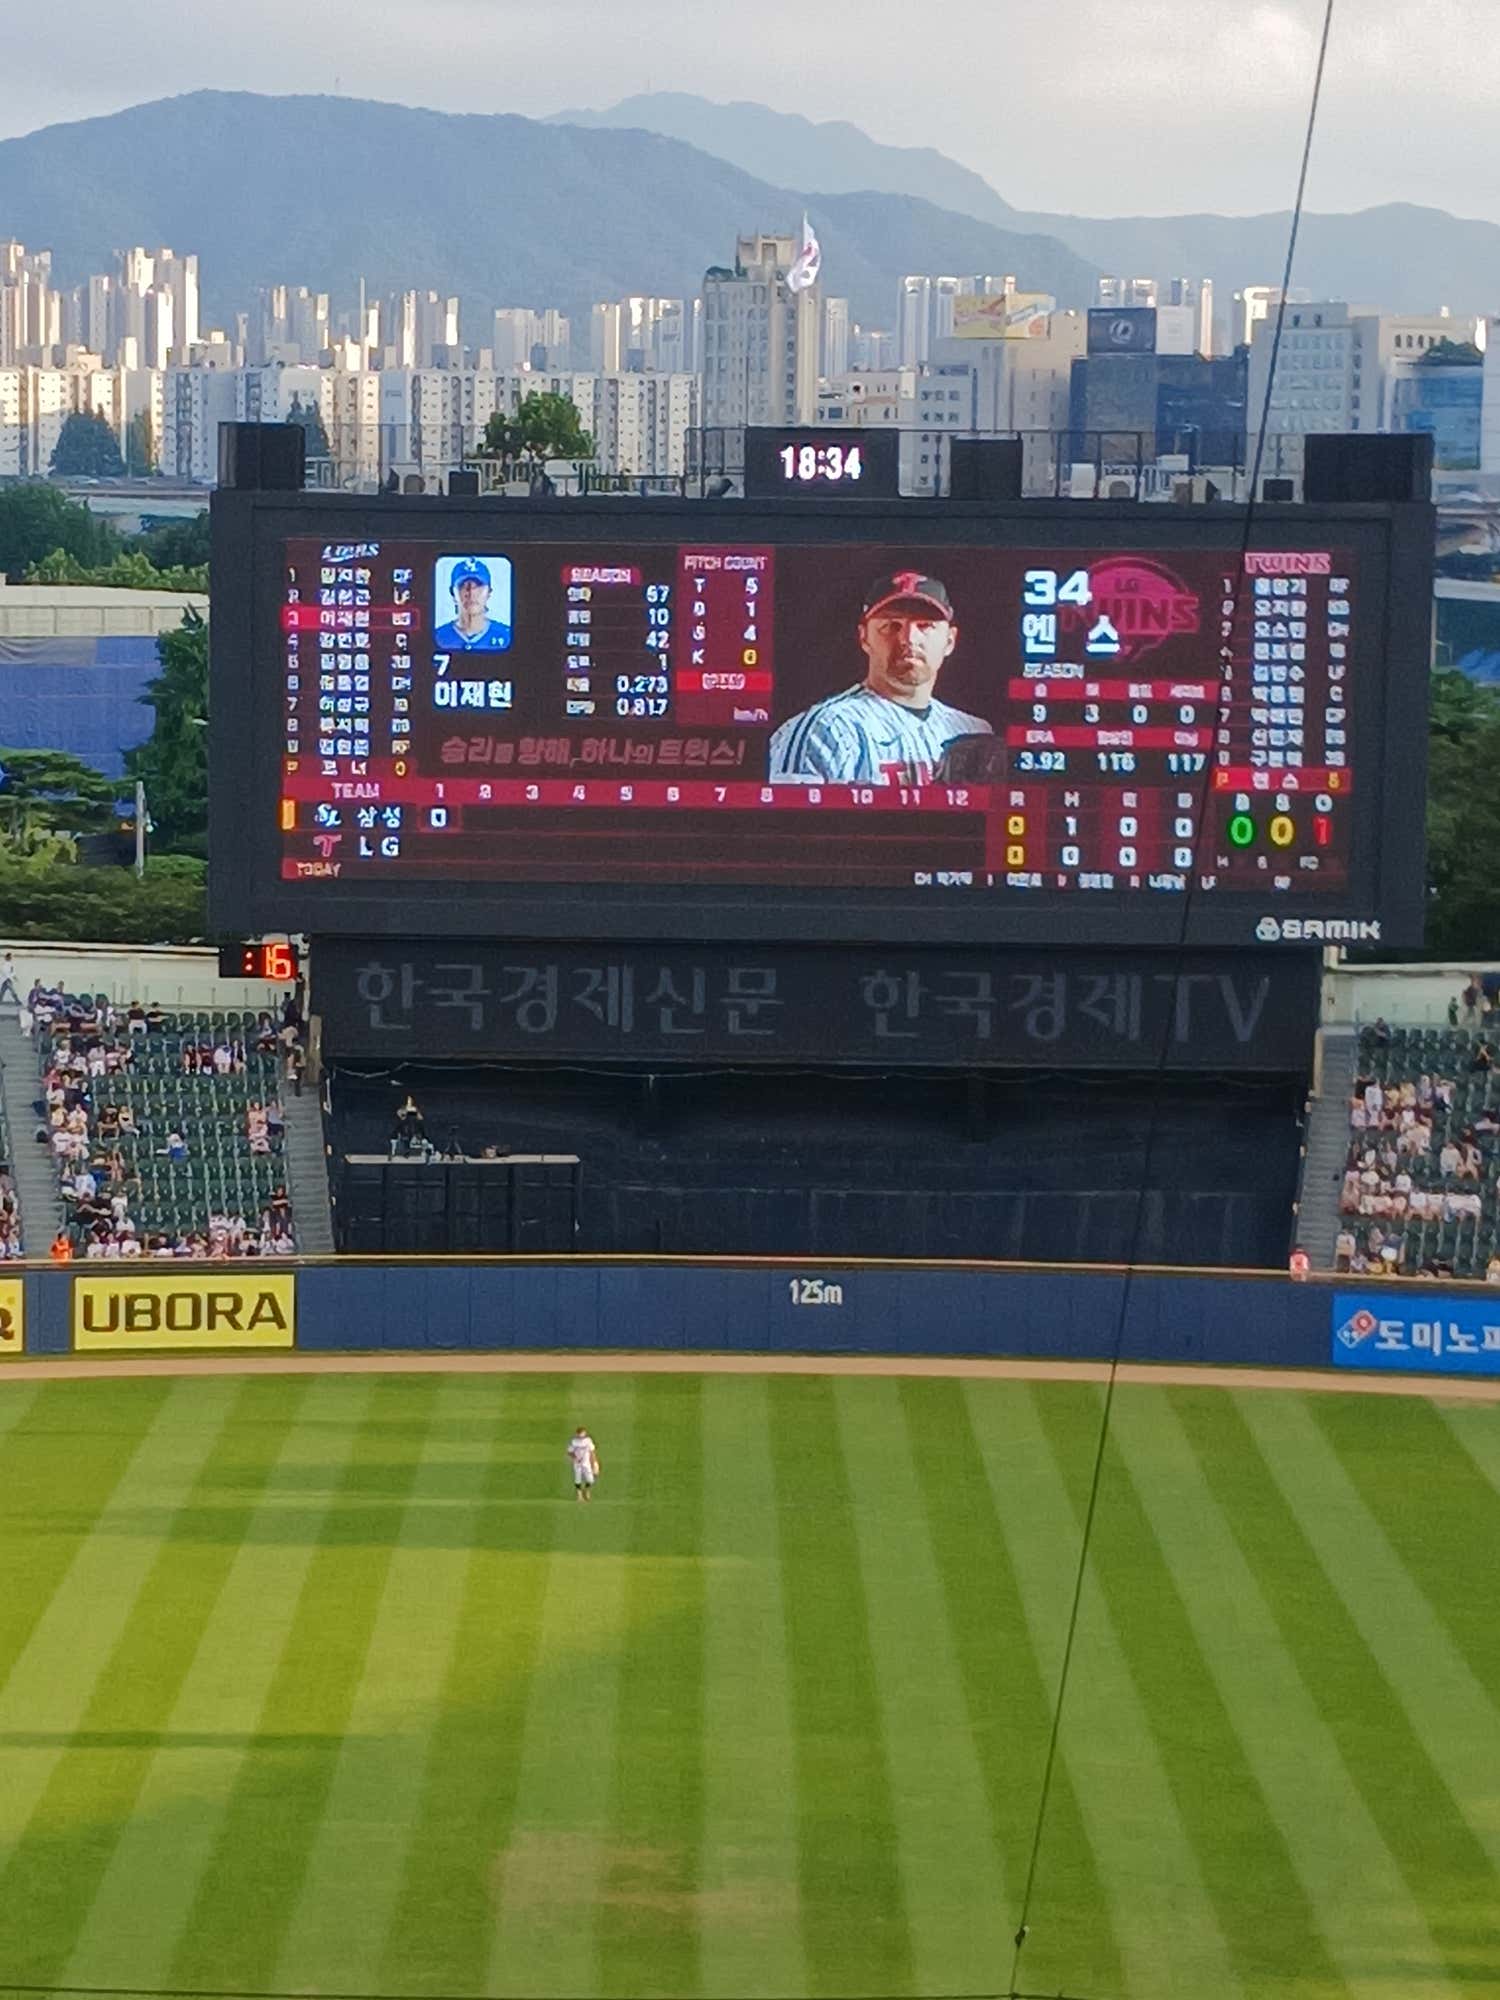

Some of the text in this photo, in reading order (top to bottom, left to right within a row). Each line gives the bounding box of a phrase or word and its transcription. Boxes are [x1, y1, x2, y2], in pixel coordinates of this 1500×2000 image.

[780, 446, 861, 480] 18:34
[685, 556, 721, 570] PITCH
[1244, 552, 1331, 574] TWINS
[288, 567, 296, 582] 1
[694, 578, 705, 593] T
[1024, 570, 1093, 606] 34
[1223, 578, 1232, 593] 1
[649, 608, 670, 625] 10
[745, 601, 755, 617] 1
[646, 630, 670, 648] 42
[743, 624, 757, 641] 4
[433, 654, 450, 675] 7
[658, 653, 668, 671] 1
[692, 649, 704, 665] K
[1023, 662, 1085, 678] SEASON
[435, 681, 512, 708] 이재현
[616, 675, 668, 694] 0.273
[287, 697, 298, 711] 7
[616, 698, 668, 716] 0.817
[1133, 704, 1148, 724] 0
[1179, 704, 1195, 724] 0
[581, 736, 653, 765] 하나의
[656, 738, 746, 766] 트윈스!
[1168, 753, 1206, 773] 117
[331, 782, 380, 799] TEAM
[435, 783, 445, 798] 1
[478, 784, 492, 799] 2
[526, 785, 539, 800] 3
[573, 785, 586, 800] 4
[620, 786, 632, 801] 5
[667, 787, 679, 801] 6
[714, 787, 727, 802] 7
[760, 788, 773, 802] 8
[851, 789, 873, 804] 10
[900, 790, 920, 805] 11
[947, 790, 968, 805] 12
[1010, 791, 1025, 806] R
[1064, 791, 1080, 808] H
[1276, 793, 1290, 811] S
[1315, 794, 1333, 812] O
[431, 808, 447, 828] 0
[1065, 816, 1077, 837] 1
[1120, 817, 1137, 837] 0
[1231, 816, 1330, 845] 0 0 1
[1062, 846, 1079, 866] 0
[297, 862, 342, 877] TODAY
[1282, 919, 1381, 940] SAMIK
[354, 960, 785, 1035] 한국경제신문
[859, 969, 1271, 1043] 한국경제TV
[790, 1279, 842, 1305] 125m
[82, 1291, 287, 1333] UBORA
